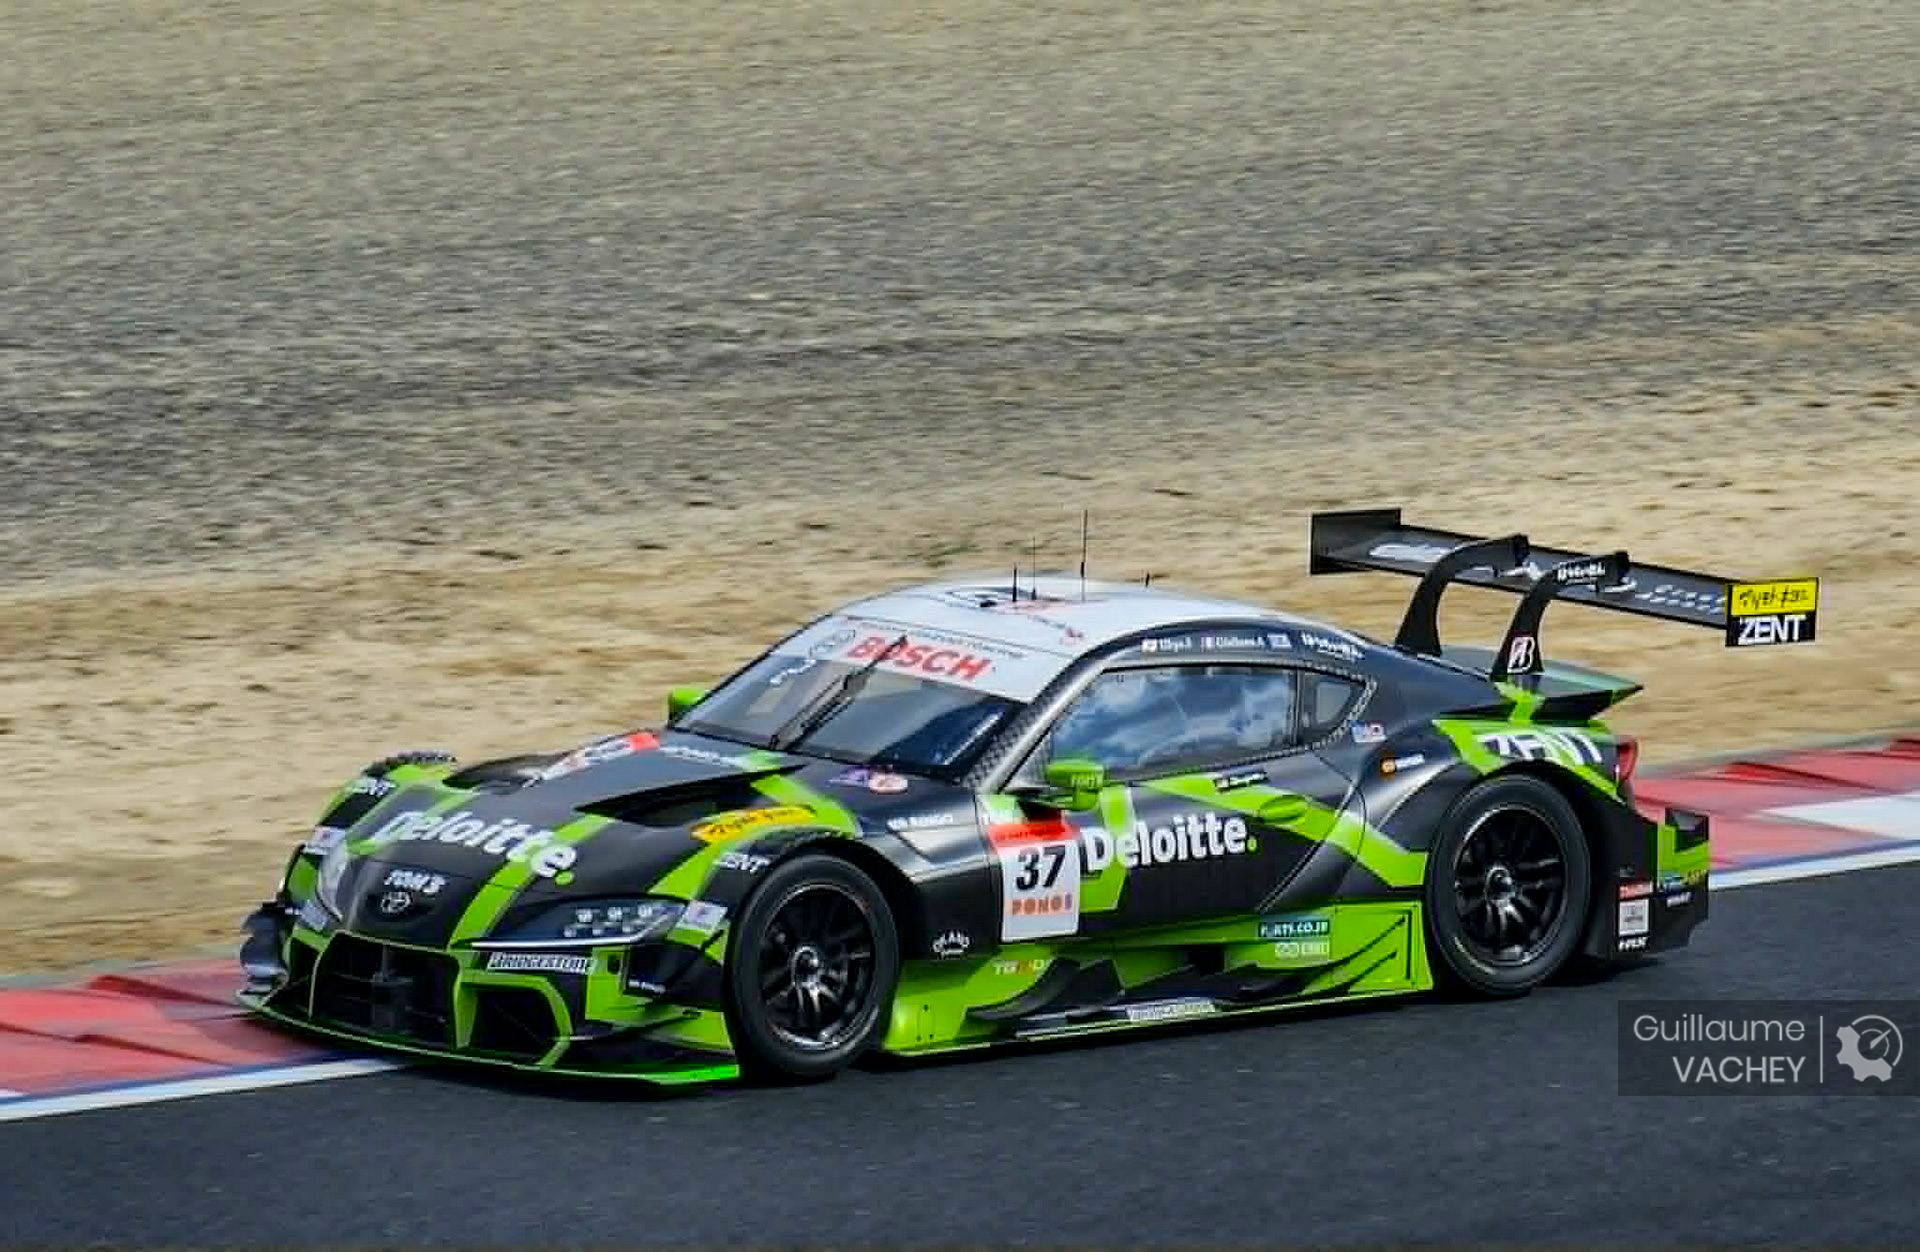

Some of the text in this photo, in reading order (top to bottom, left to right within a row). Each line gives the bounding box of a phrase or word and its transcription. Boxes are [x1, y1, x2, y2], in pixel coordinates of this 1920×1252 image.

[1738, 614, 1806, 645] ZENT
[375, 811, 577, 885] Deloitte.
[1015, 845, 1067, 891] 37
[1081, 811, 1258, 873] Deloitte.
